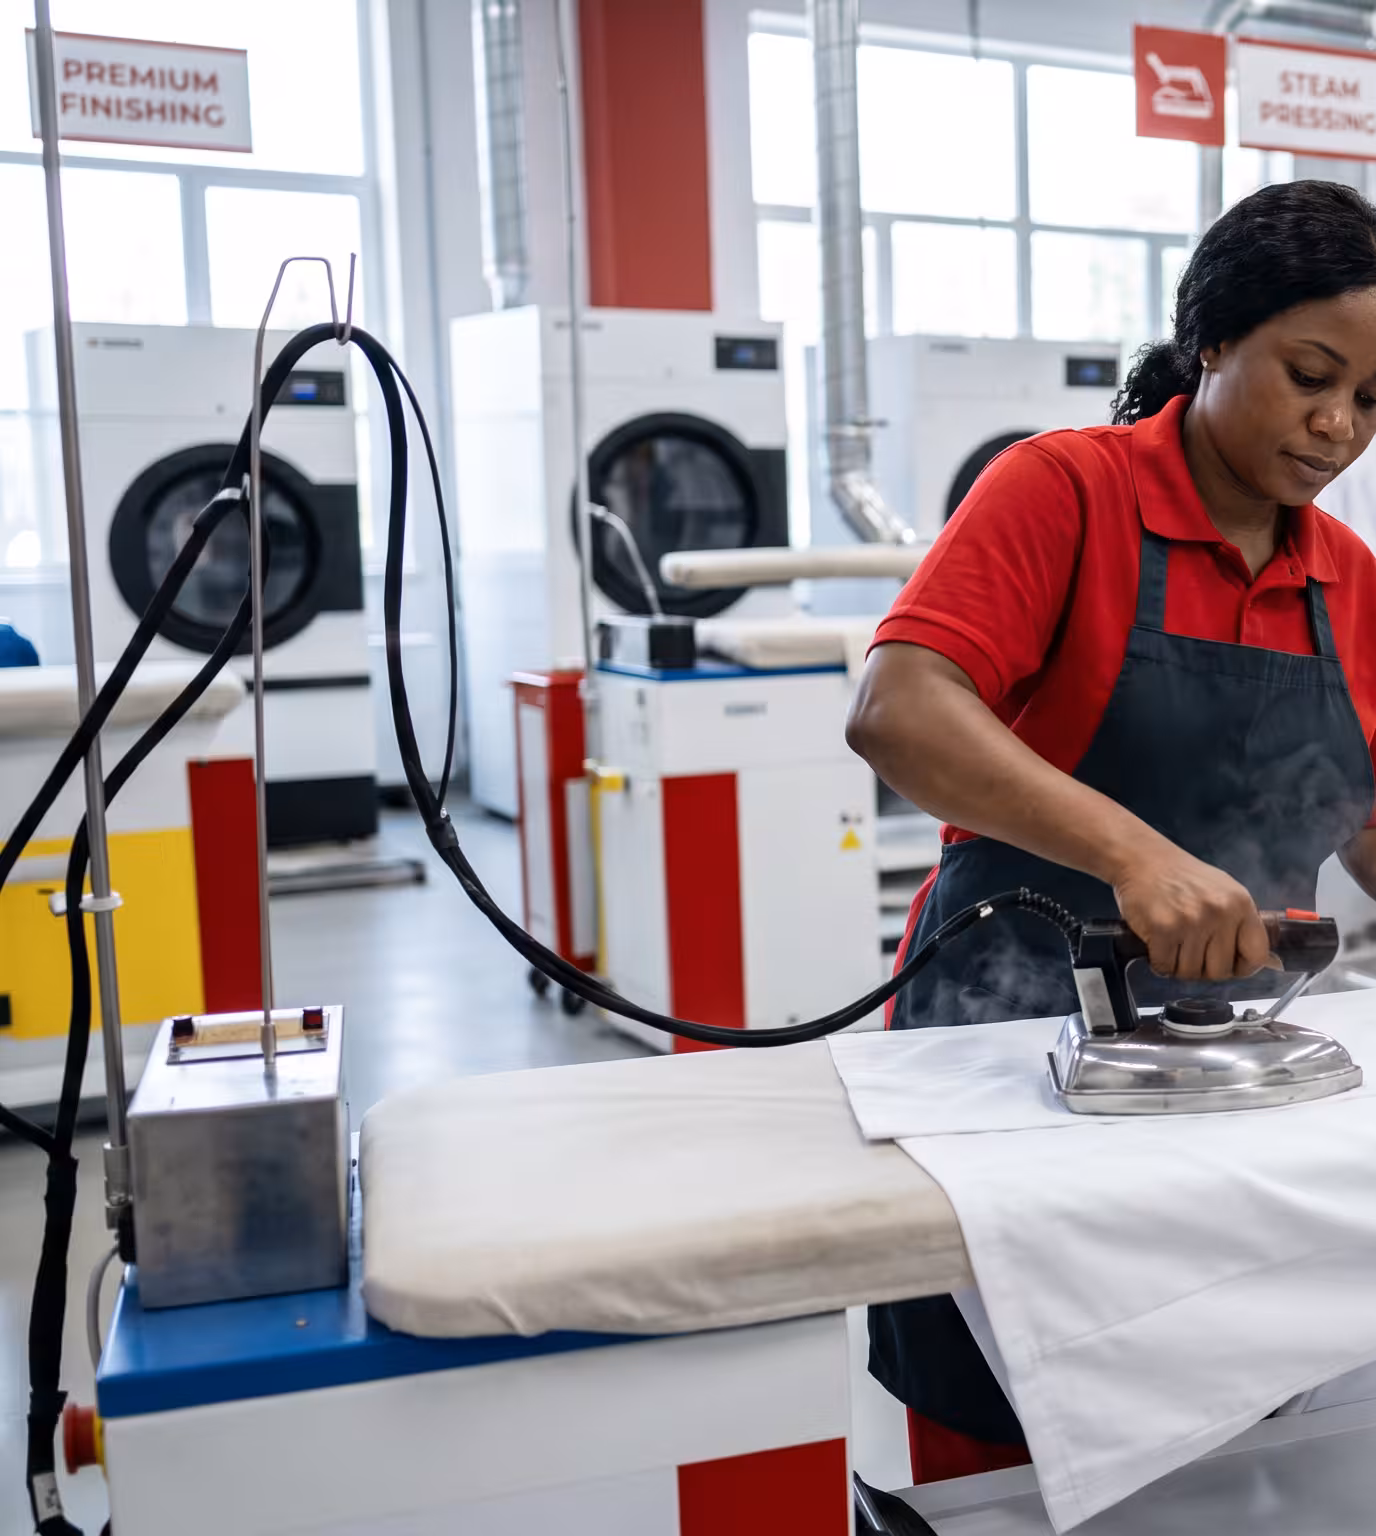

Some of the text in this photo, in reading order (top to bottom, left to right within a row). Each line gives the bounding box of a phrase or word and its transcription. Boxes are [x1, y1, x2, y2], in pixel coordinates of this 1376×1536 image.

[62, 58, 220, 94] PREMIUM
[1279, 70, 1360, 98] STEAM
[60, 92, 225, 128] FINISHING
